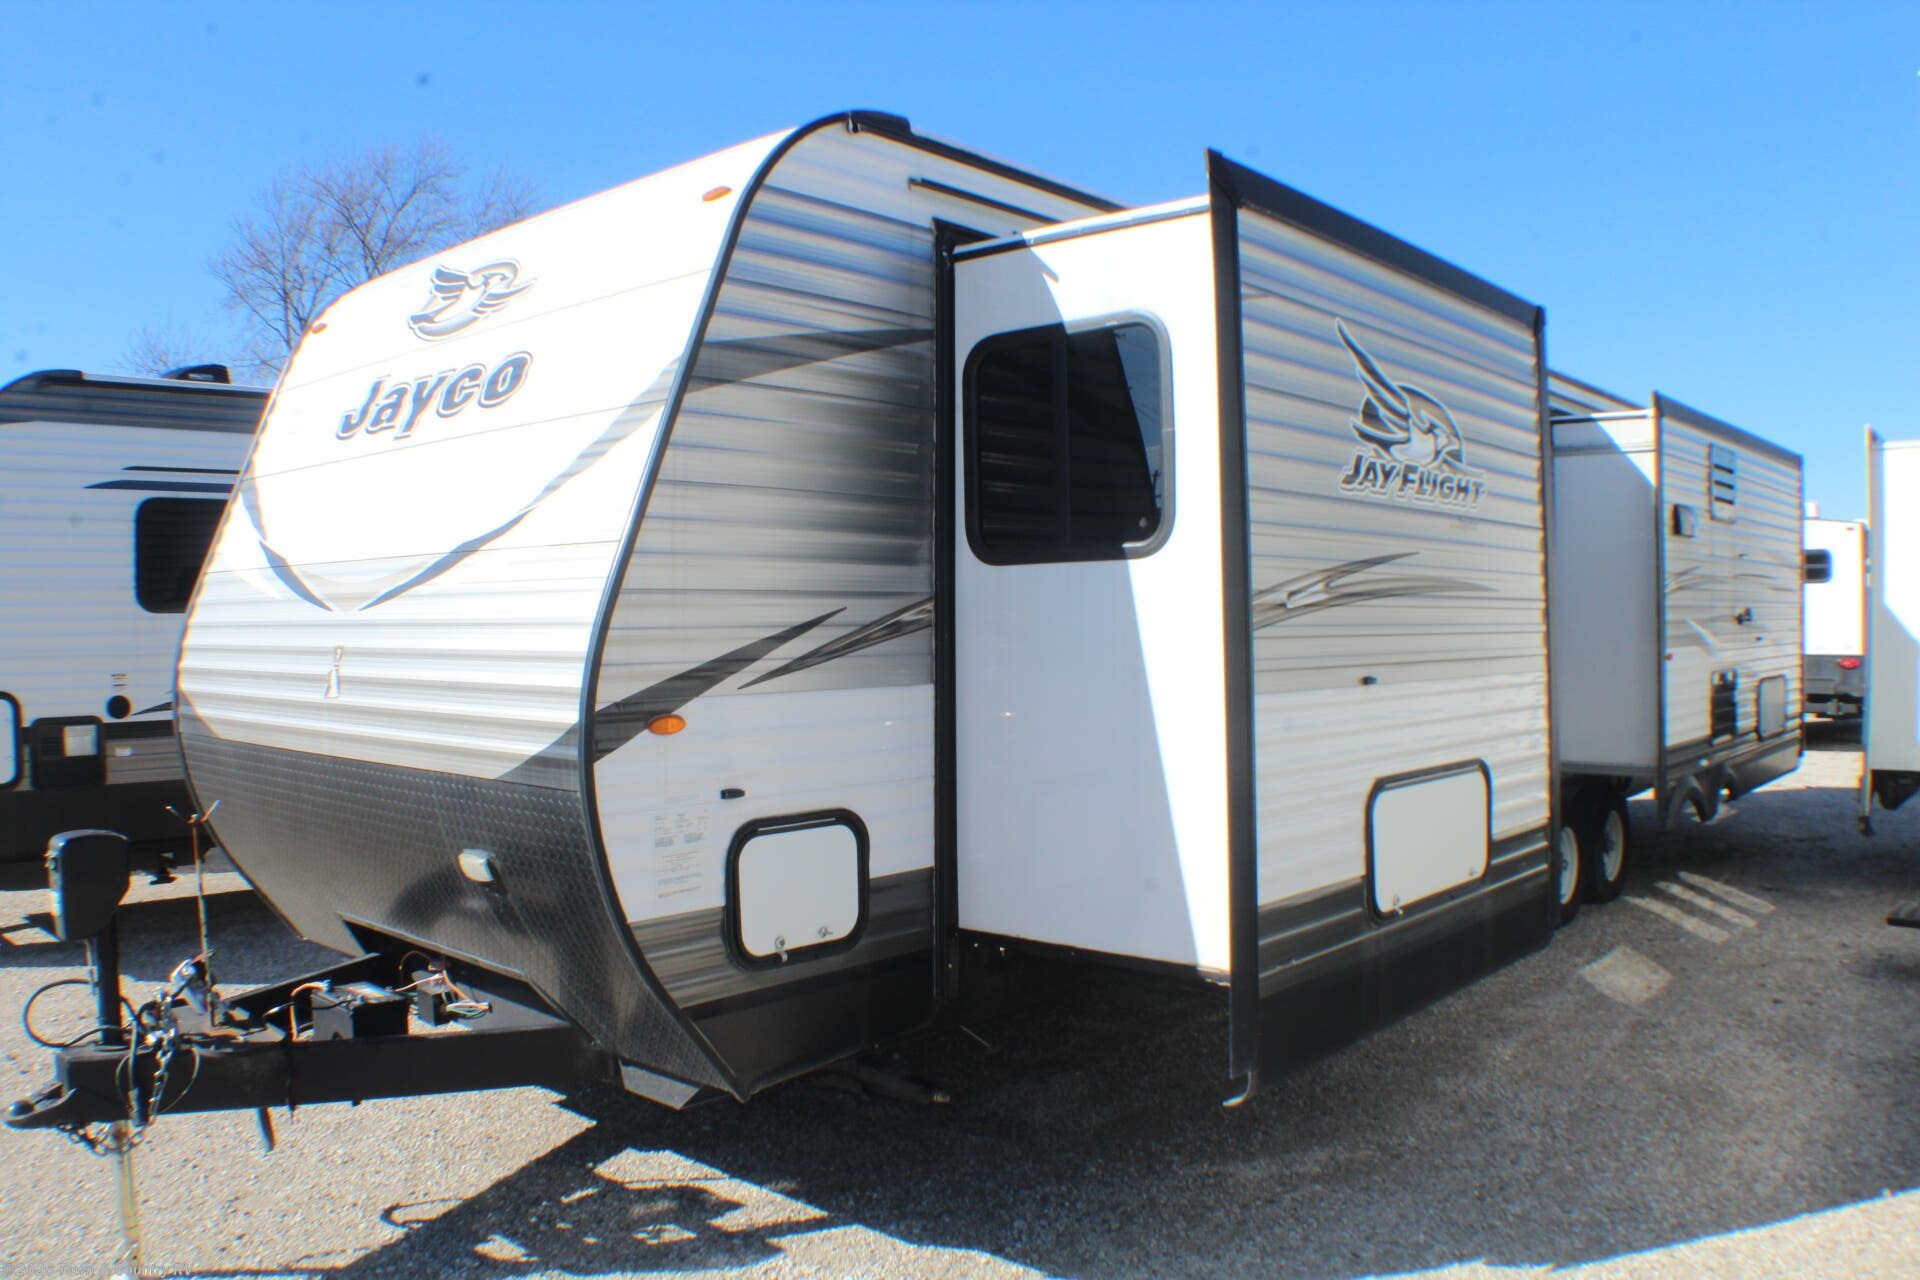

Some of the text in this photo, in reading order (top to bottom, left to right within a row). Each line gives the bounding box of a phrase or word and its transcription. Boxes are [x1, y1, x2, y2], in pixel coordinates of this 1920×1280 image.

[336, 351, 533, 441] Jayco
[1339, 451, 1487, 506] JAY FLIGHT
